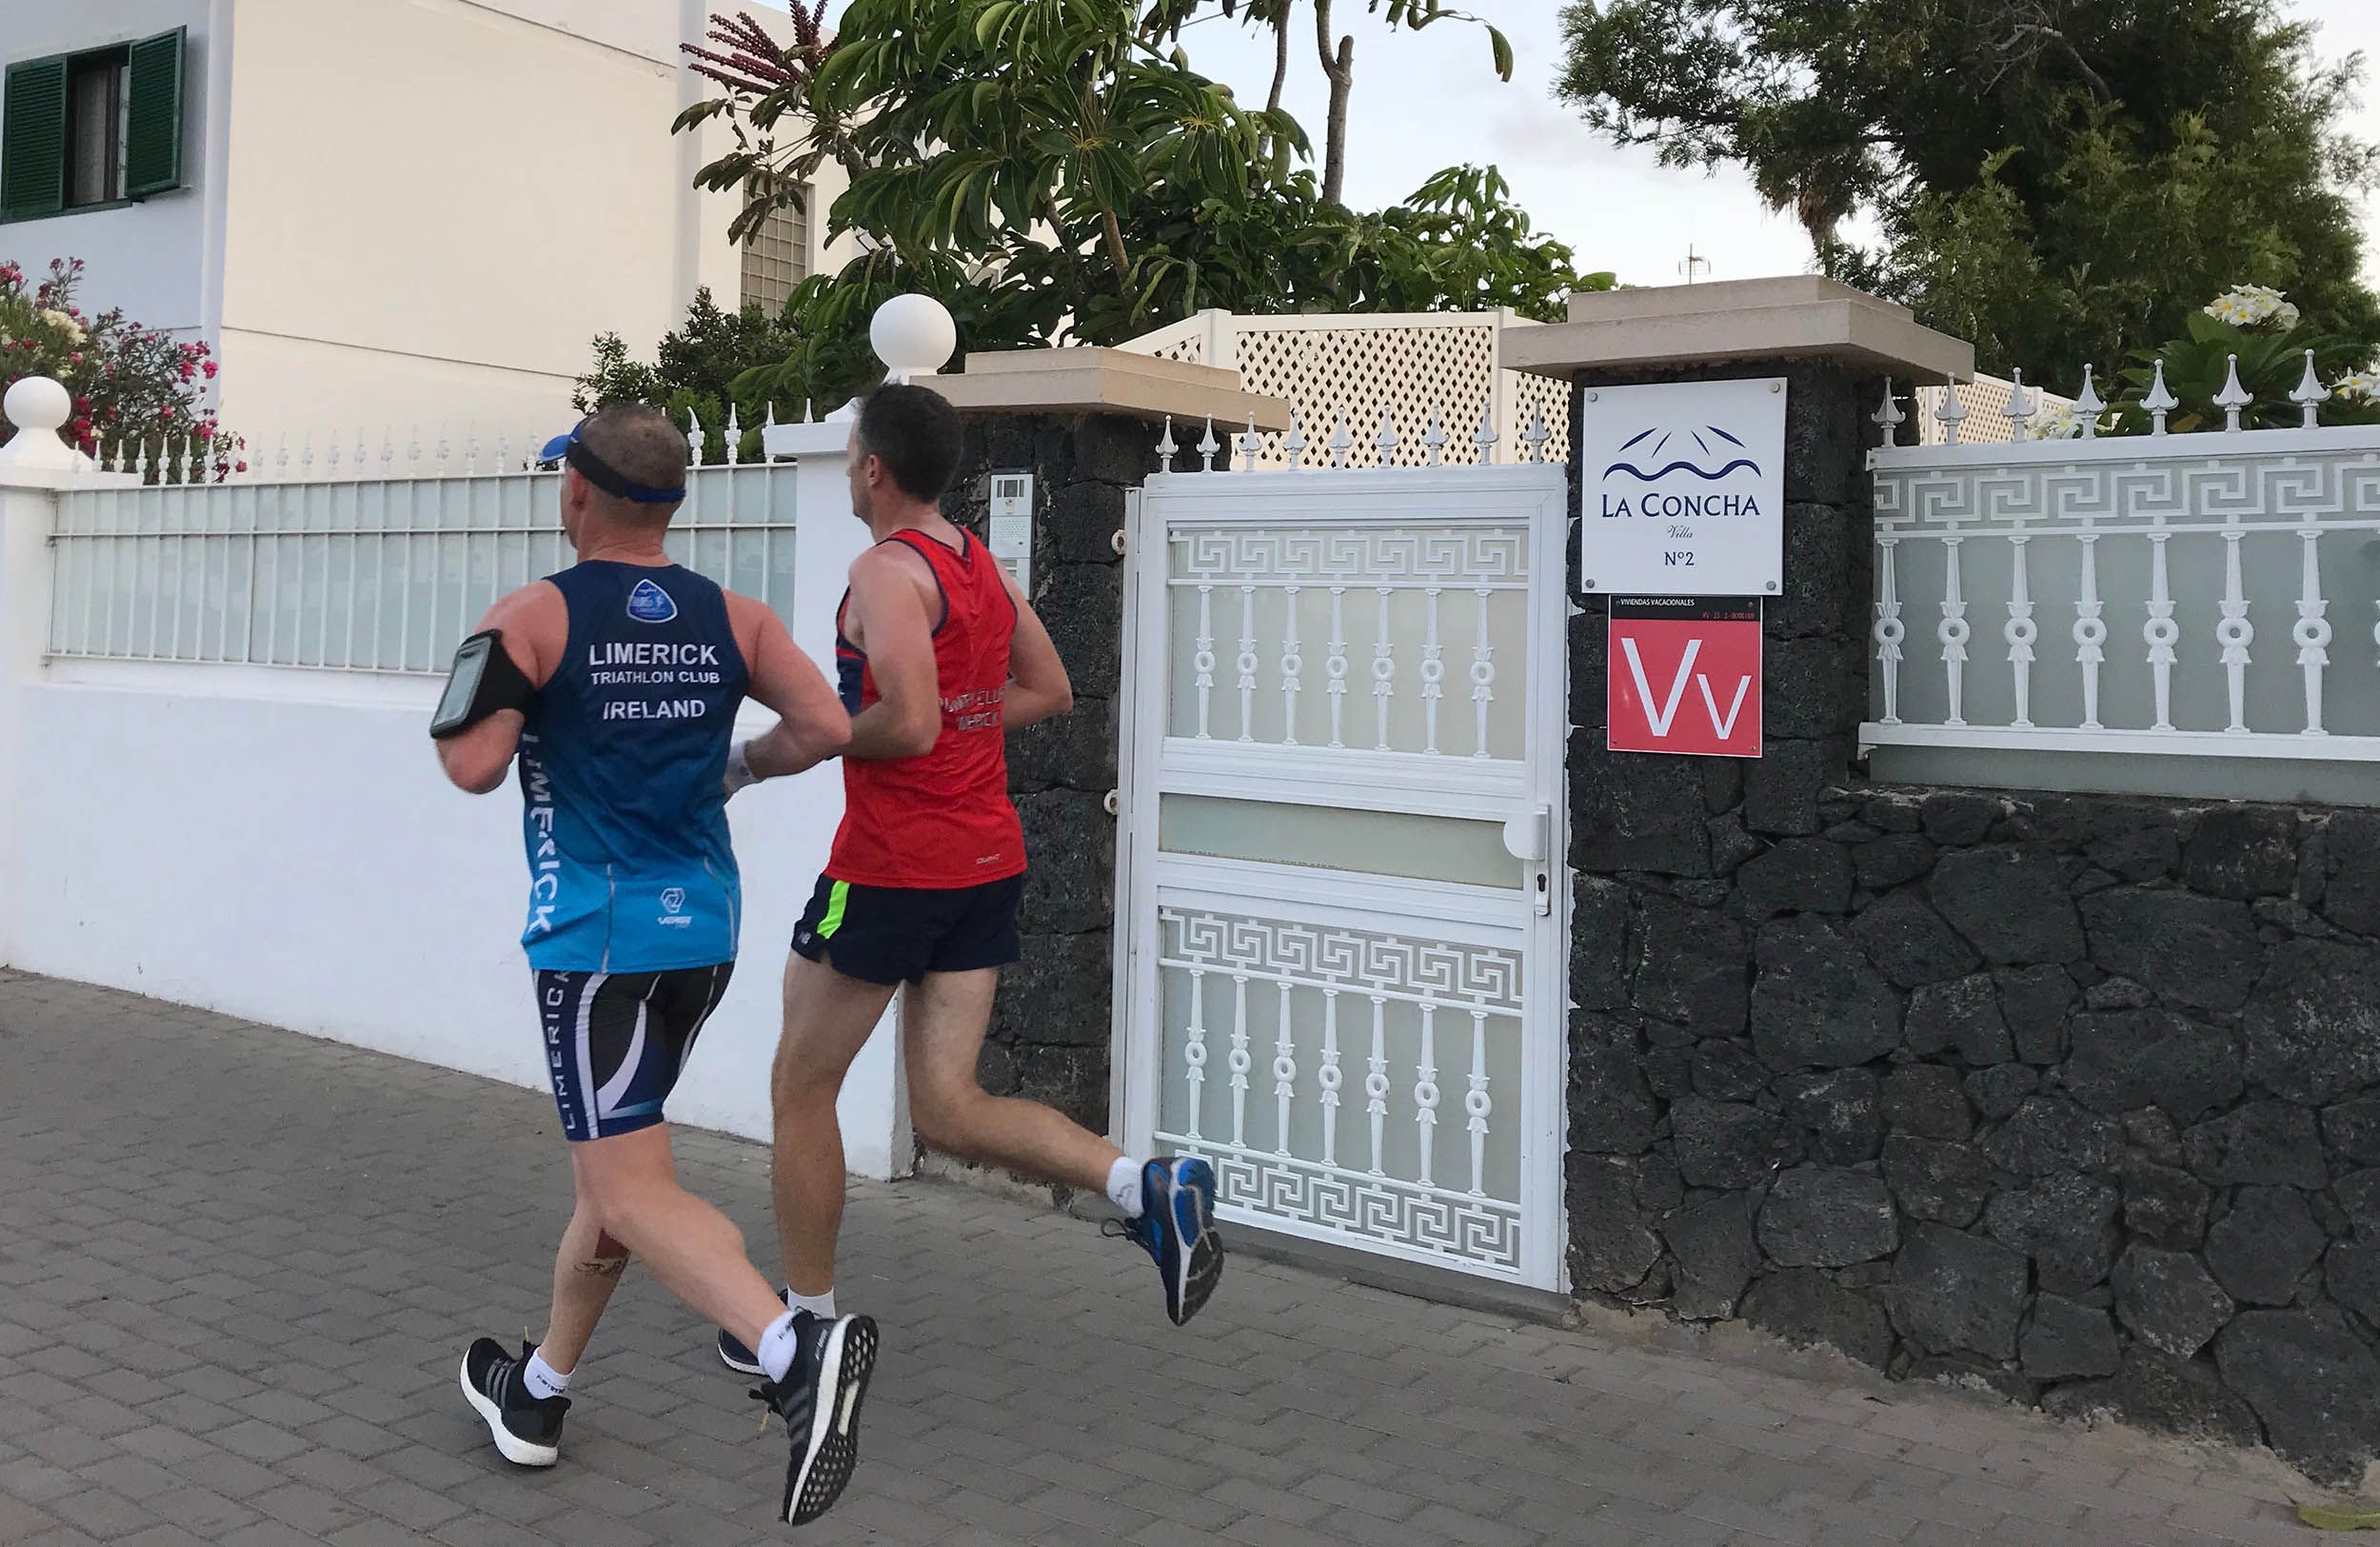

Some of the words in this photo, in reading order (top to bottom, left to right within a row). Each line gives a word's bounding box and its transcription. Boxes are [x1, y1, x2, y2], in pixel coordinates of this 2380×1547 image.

[1667, 525, 1693, 539] Villa
[1620, 598, 1650, 606] VIVIENDAS
[589, 642, 719, 665] LIMERICK
[591, 670, 674, 684] TRIATHLON
[678, 671, 721, 684] CLUB
[603, 700, 705, 720] IRELAND
